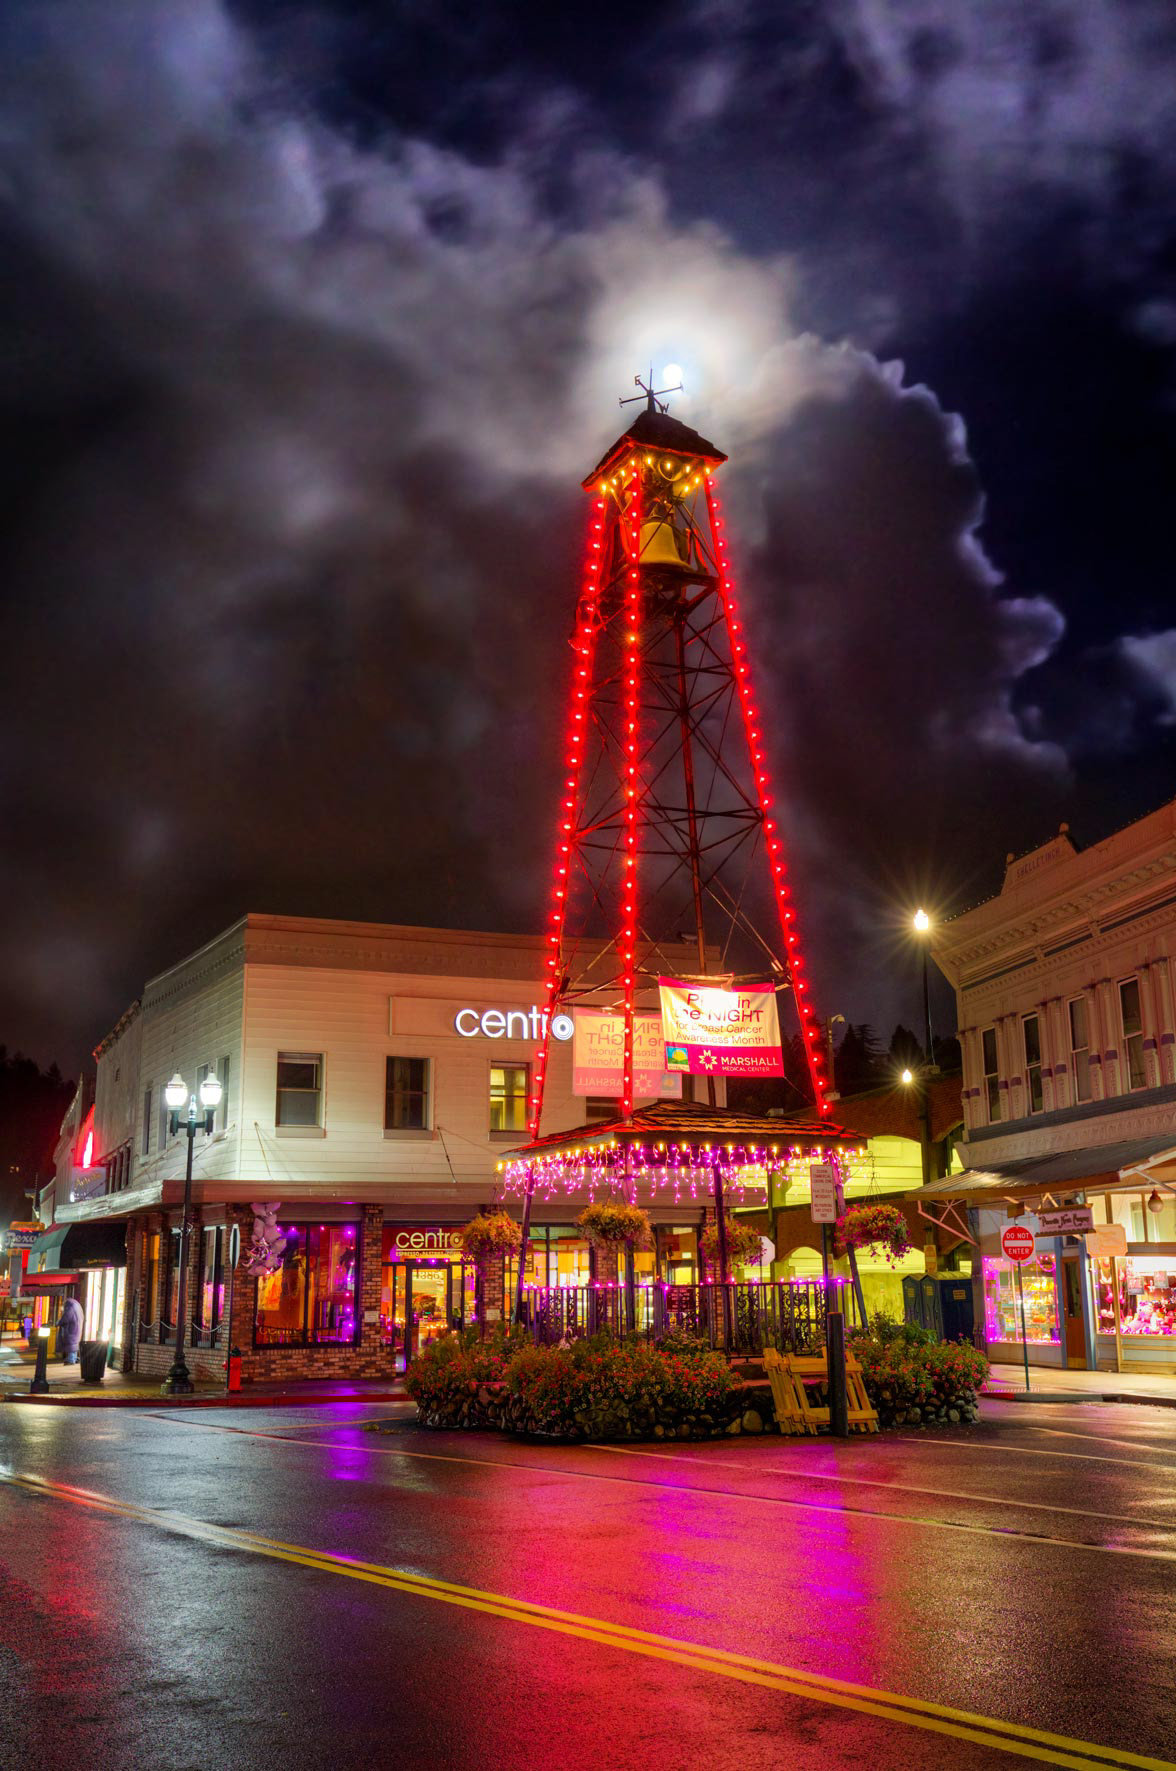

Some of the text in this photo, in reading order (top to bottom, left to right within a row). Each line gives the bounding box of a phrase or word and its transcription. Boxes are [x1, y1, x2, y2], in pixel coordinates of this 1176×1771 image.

[737, 996, 751, 1009] in
[455, 1005, 575, 1040] centro
[708, 1009, 764, 1023] NIGHT
[726, 1024, 763, 1034] Cancer
[675, 1032, 765, 1044] Awareness Month
[720, 1056, 779, 1066] MARSHALL
[396, 1228, 464, 1248] centro
